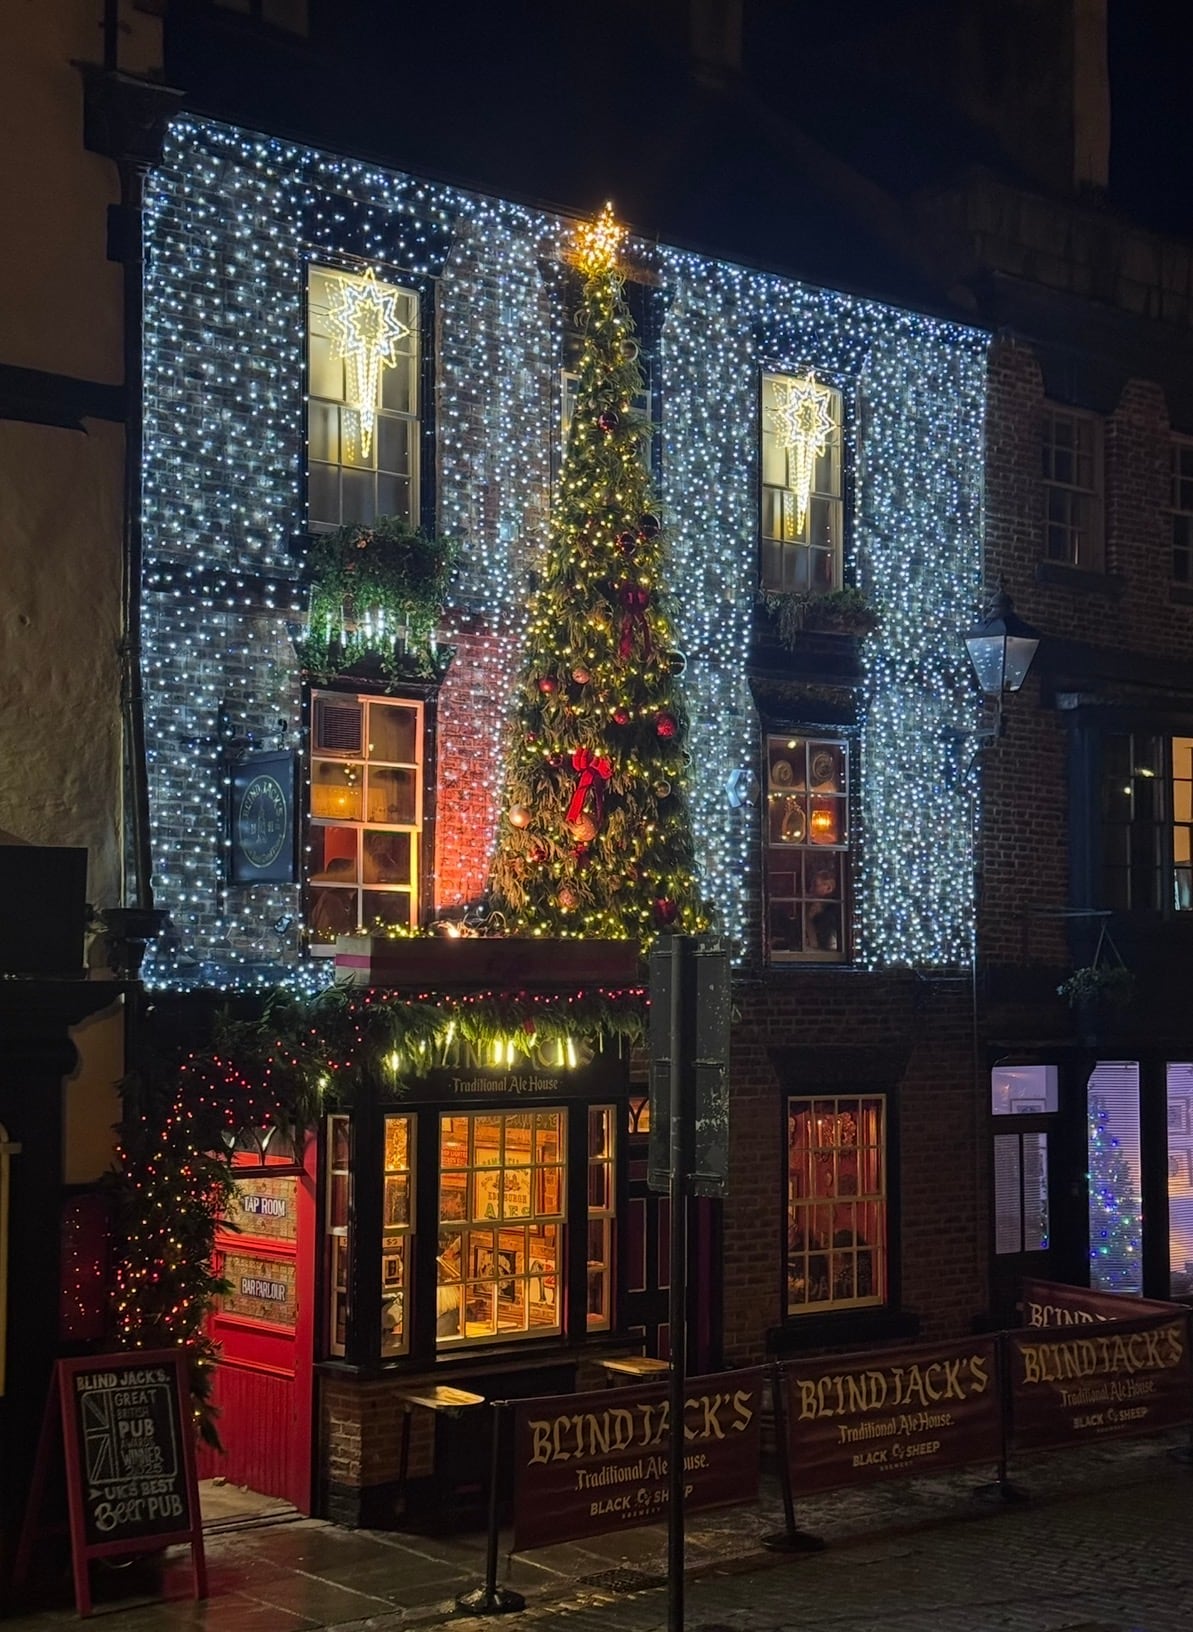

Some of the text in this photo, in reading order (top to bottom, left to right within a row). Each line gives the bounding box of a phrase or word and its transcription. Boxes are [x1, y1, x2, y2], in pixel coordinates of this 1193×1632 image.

[452, 1075, 559, 1094] Traditional Ale House
[244, 1196, 286, 1217] TAP ROOM
[242, 1278, 286, 1301] BAR PARLOUR
[1020, 1326, 1183, 1384] BLIND JACK'S
[75, 1373, 118, 1390] BLIND
[796, 1354, 989, 1421] BLIND JACK'S
[1110, 1380, 1127, 1401] Ale
[114, 1390, 157, 1407] GREAT
[118, 1419, 155, 1439] PUB
[896, 1414, 918, 1436] Ale
[1073, 1414, 1105, 1429] BLACK
[1119, 1406, 1149, 1421] SHEEP
[527, 1408, 634, 1466] BLIND
[853, 1440, 941, 1467] BLACK SHEEP
[644, 1455, 669, 1481] Ale
[140, 1478, 175, 1496] BEST
[94, 1493, 183, 1531] Beer PUB
[590, 1484, 694, 1517] BLACK SHP
